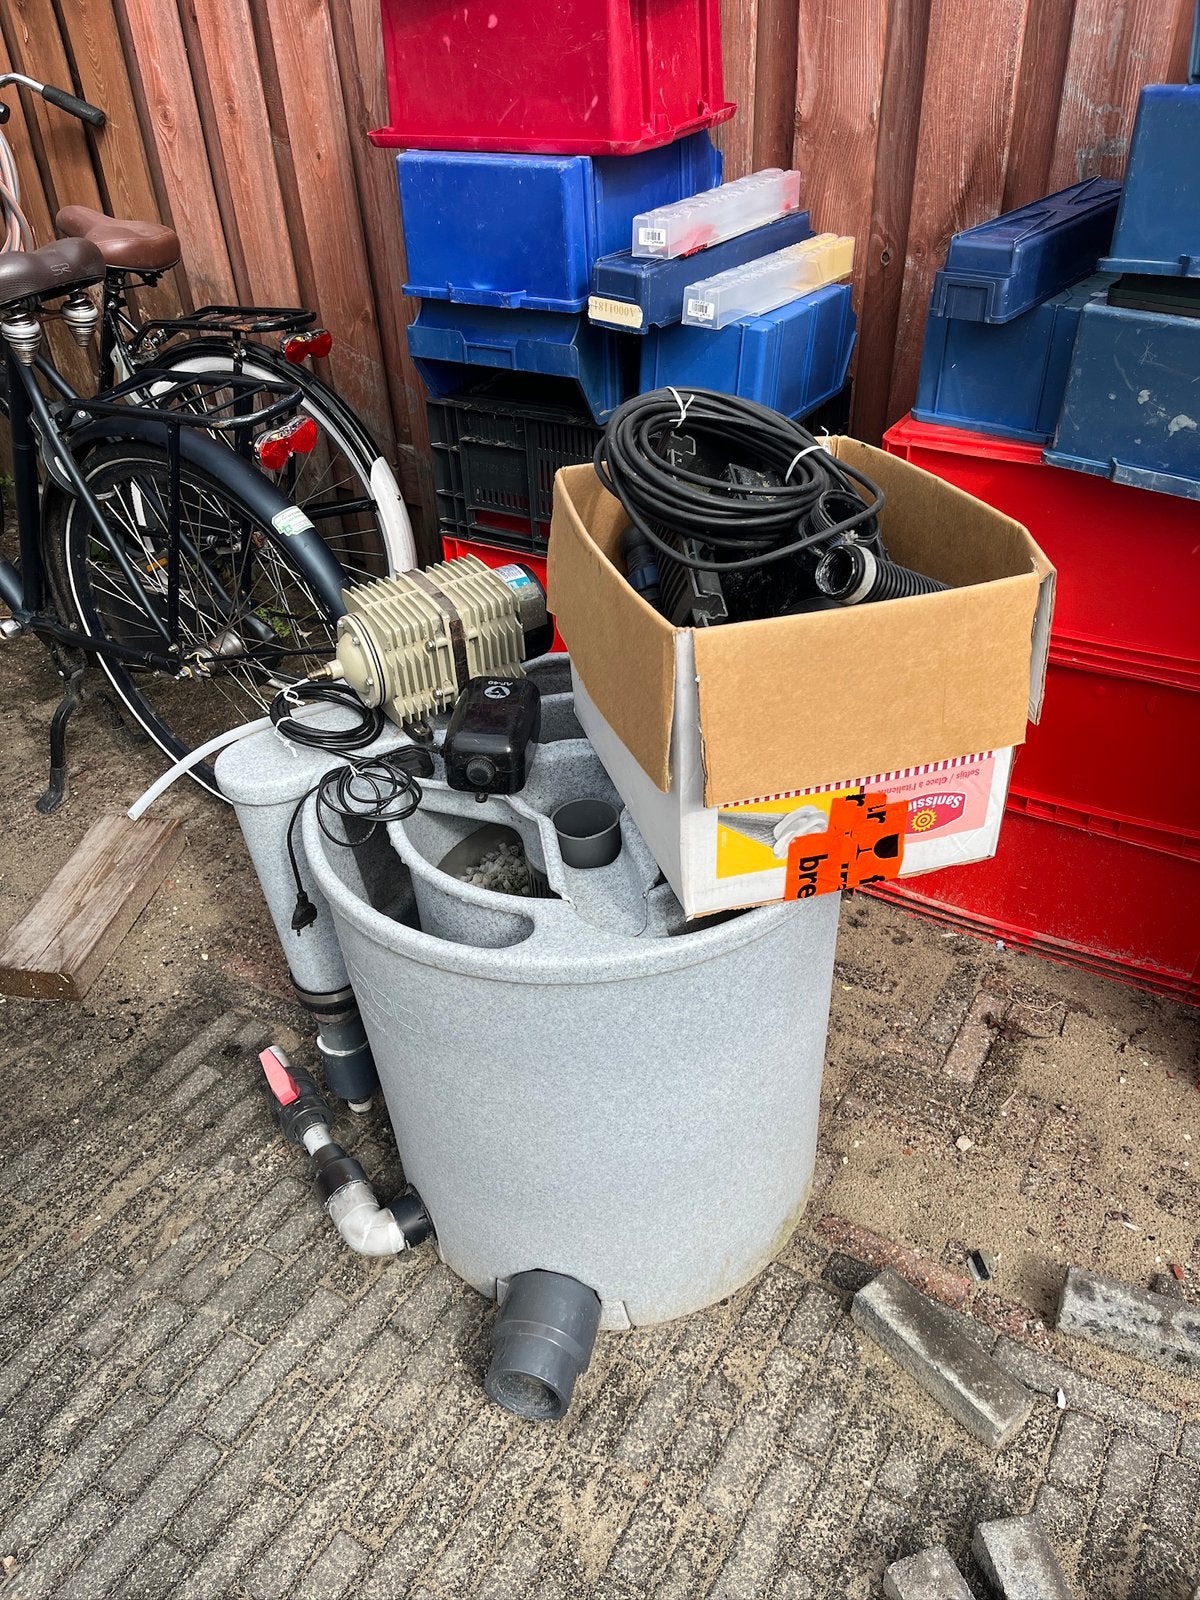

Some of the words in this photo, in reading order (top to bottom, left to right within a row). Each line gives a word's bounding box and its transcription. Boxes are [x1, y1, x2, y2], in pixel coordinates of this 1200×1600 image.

[956, 768, 981, 780] Softijs
[925, 777, 948, 786] Glace
[797, 853, 829, 898] bre
